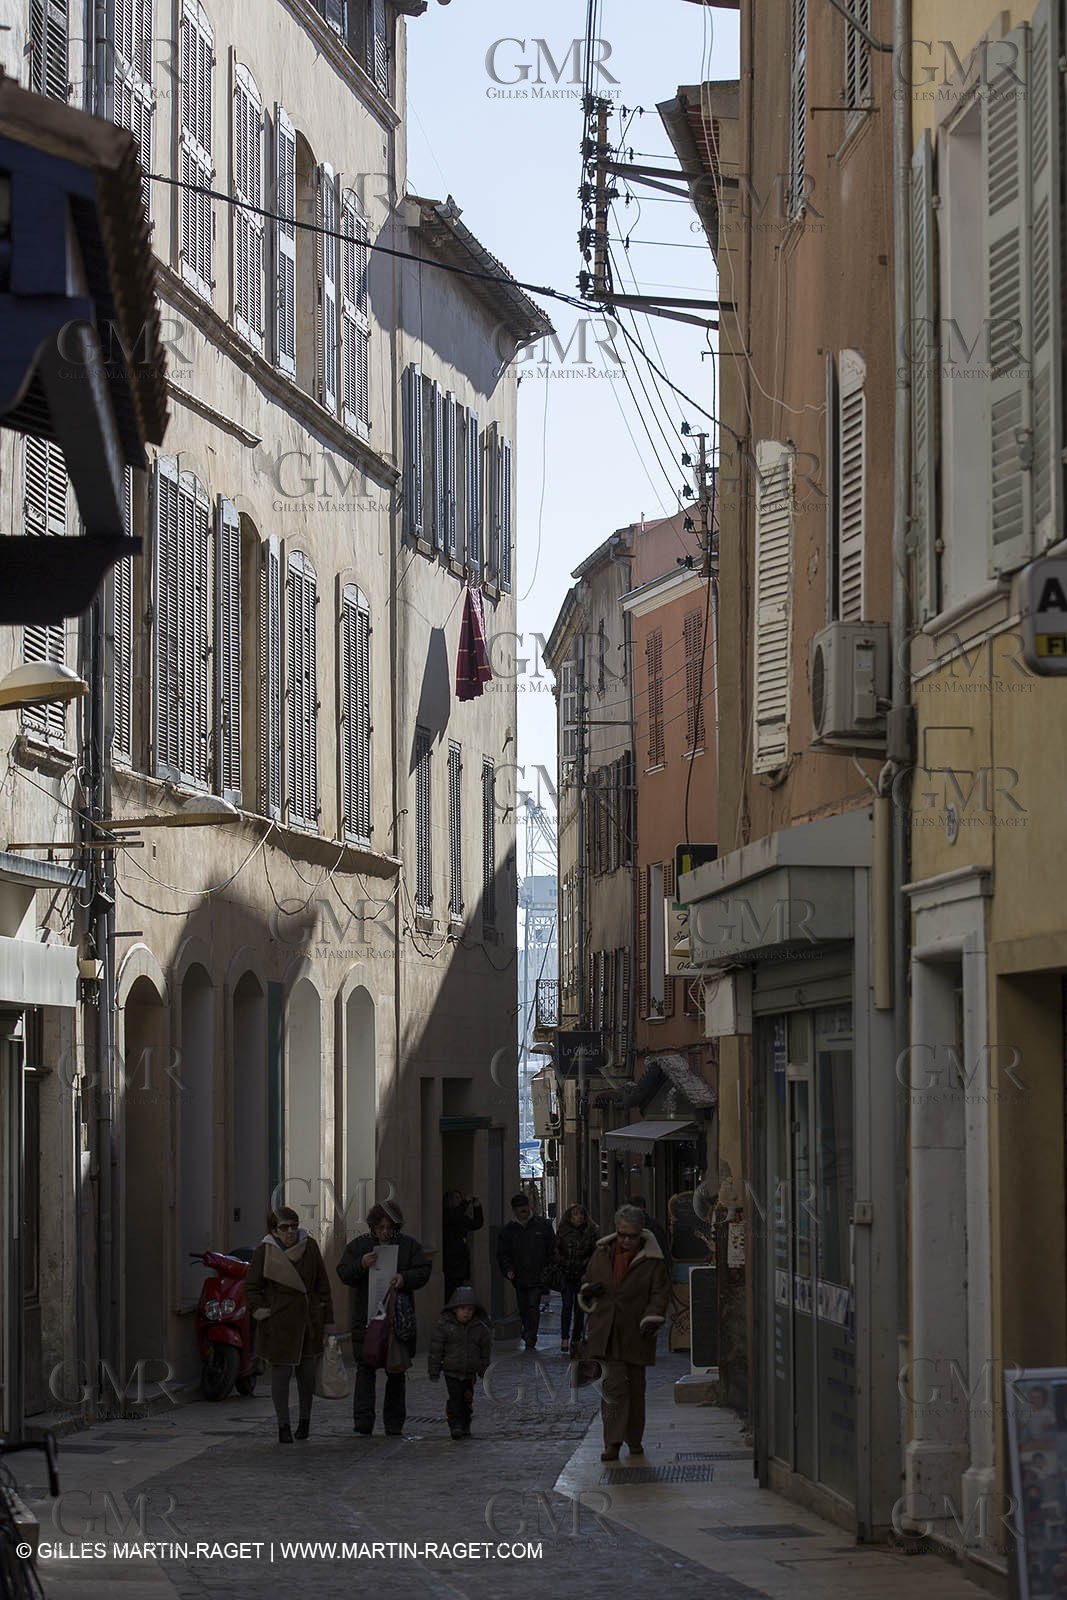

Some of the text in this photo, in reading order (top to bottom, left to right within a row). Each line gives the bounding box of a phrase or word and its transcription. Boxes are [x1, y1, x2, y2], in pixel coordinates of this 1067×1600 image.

[1038, 577, 1067, 613] A
[1047, 636, 1067, 654] F
[673, 931, 689, 943] Sp
